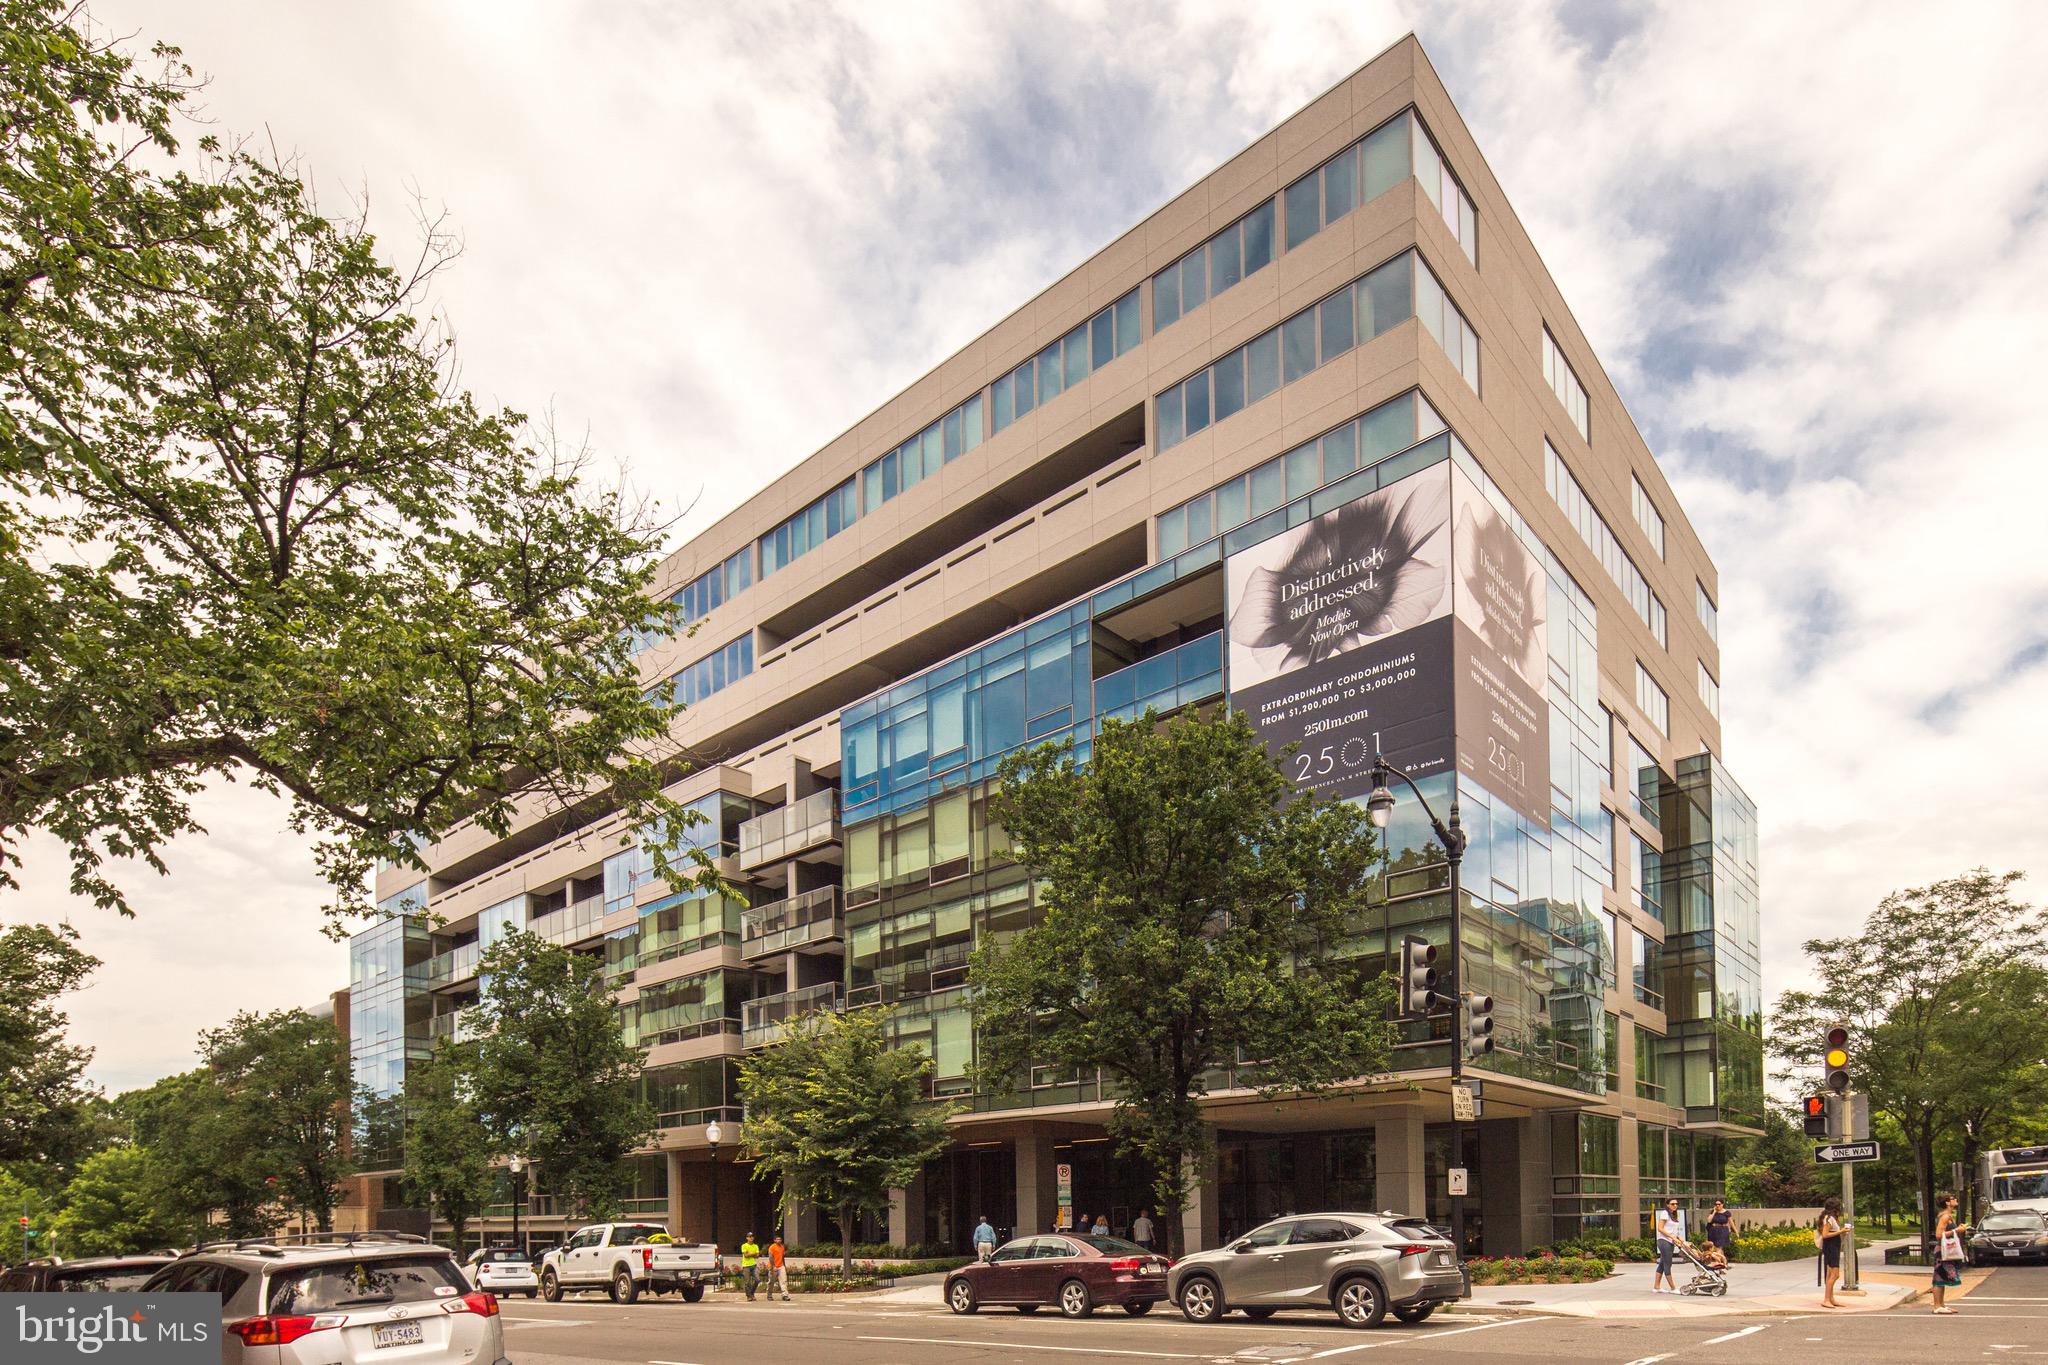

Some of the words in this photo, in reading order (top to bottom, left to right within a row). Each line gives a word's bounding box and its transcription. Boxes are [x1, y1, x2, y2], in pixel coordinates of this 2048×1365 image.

[1280, 547, 1387, 602] Distinctively
[1290, 571, 1378, 620] addressed.
[1309, 630, 1332, 645] Now
[1333, 620, 1358, 635] Open
[1316, 607, 1351, 629] Models
[1261, 681, 1333, 712] EXTRAORDINARY
[1337, 653, 1415, 686] CONDOMINIUMS
[1261, 712, 1285, 726] FROM
[1289, 695, 1339, 718] $1,200,000
[1343, 688, 1355, 699] TO
[1360, 668, 1416, 694] $3,000,000
[1304, 708, 1368, 737] 2501m.com
[1295, 731, 1380, 781] 2501
[1488, 736, 1525, 788] 2501
[1457, 1095, 1469, 1103] TURN
[1463, 1103, 1471, 1111] RED
[1832, 1149, 1850, 1157] ONE
[1852, 1147, 1870, 1155] WAY
